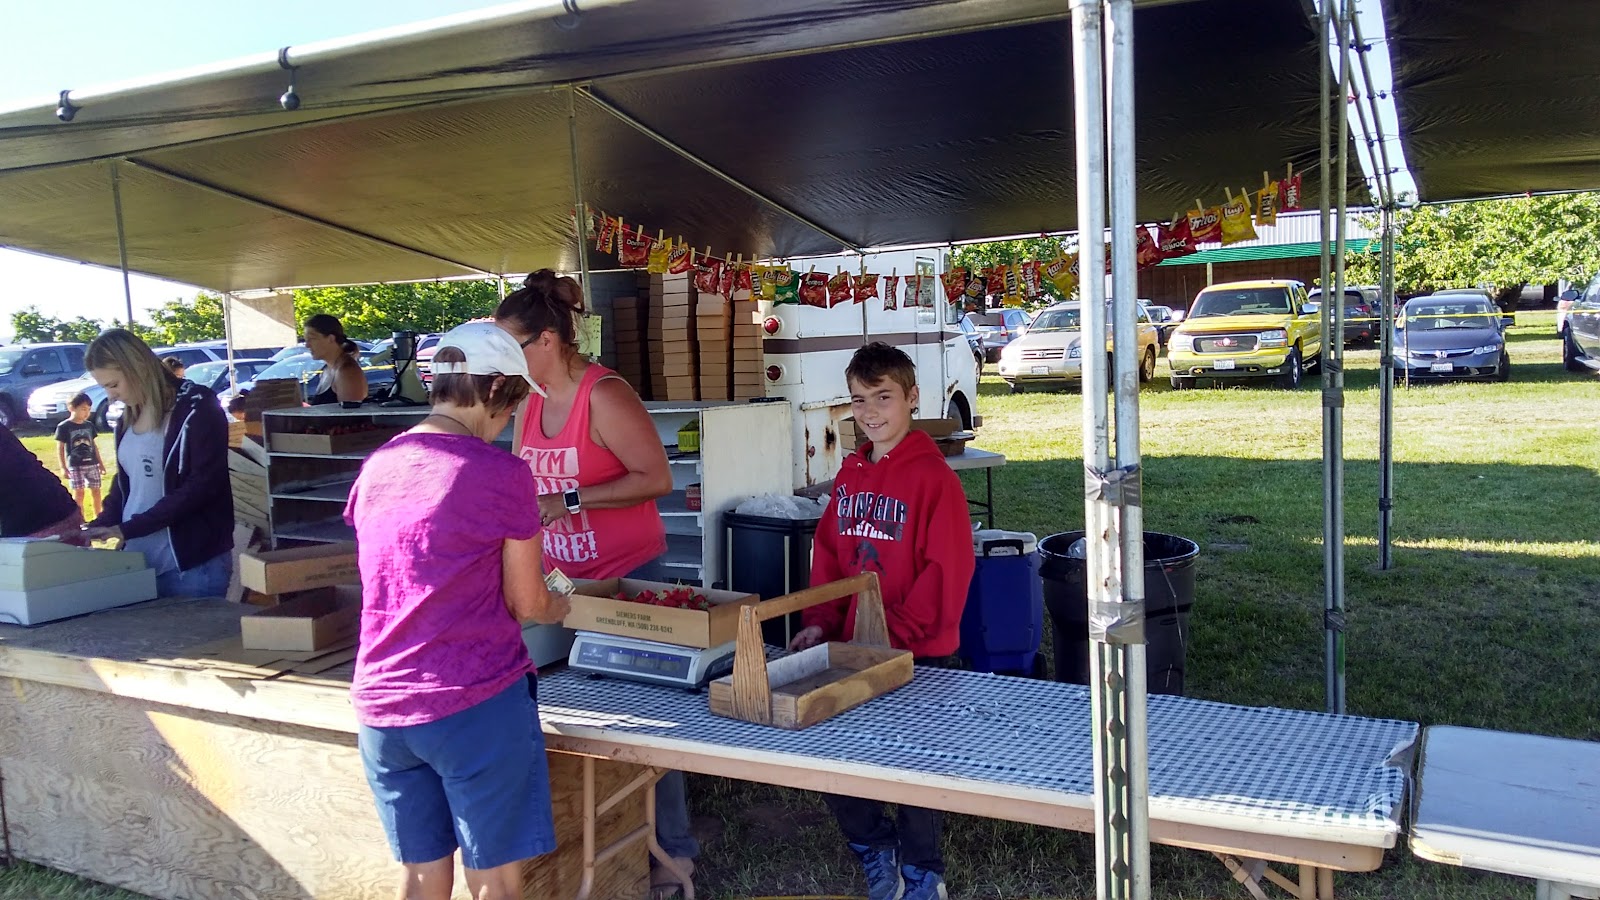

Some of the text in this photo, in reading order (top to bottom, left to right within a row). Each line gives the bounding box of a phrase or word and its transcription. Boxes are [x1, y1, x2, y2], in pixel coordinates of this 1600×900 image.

[1190, 213, 1218, 231] Fritos
[521, 450, 566, 475] GYM
[542, 530, 599, 563] ARE!
[616, 611, 651, 621] SIEMERS FARM
